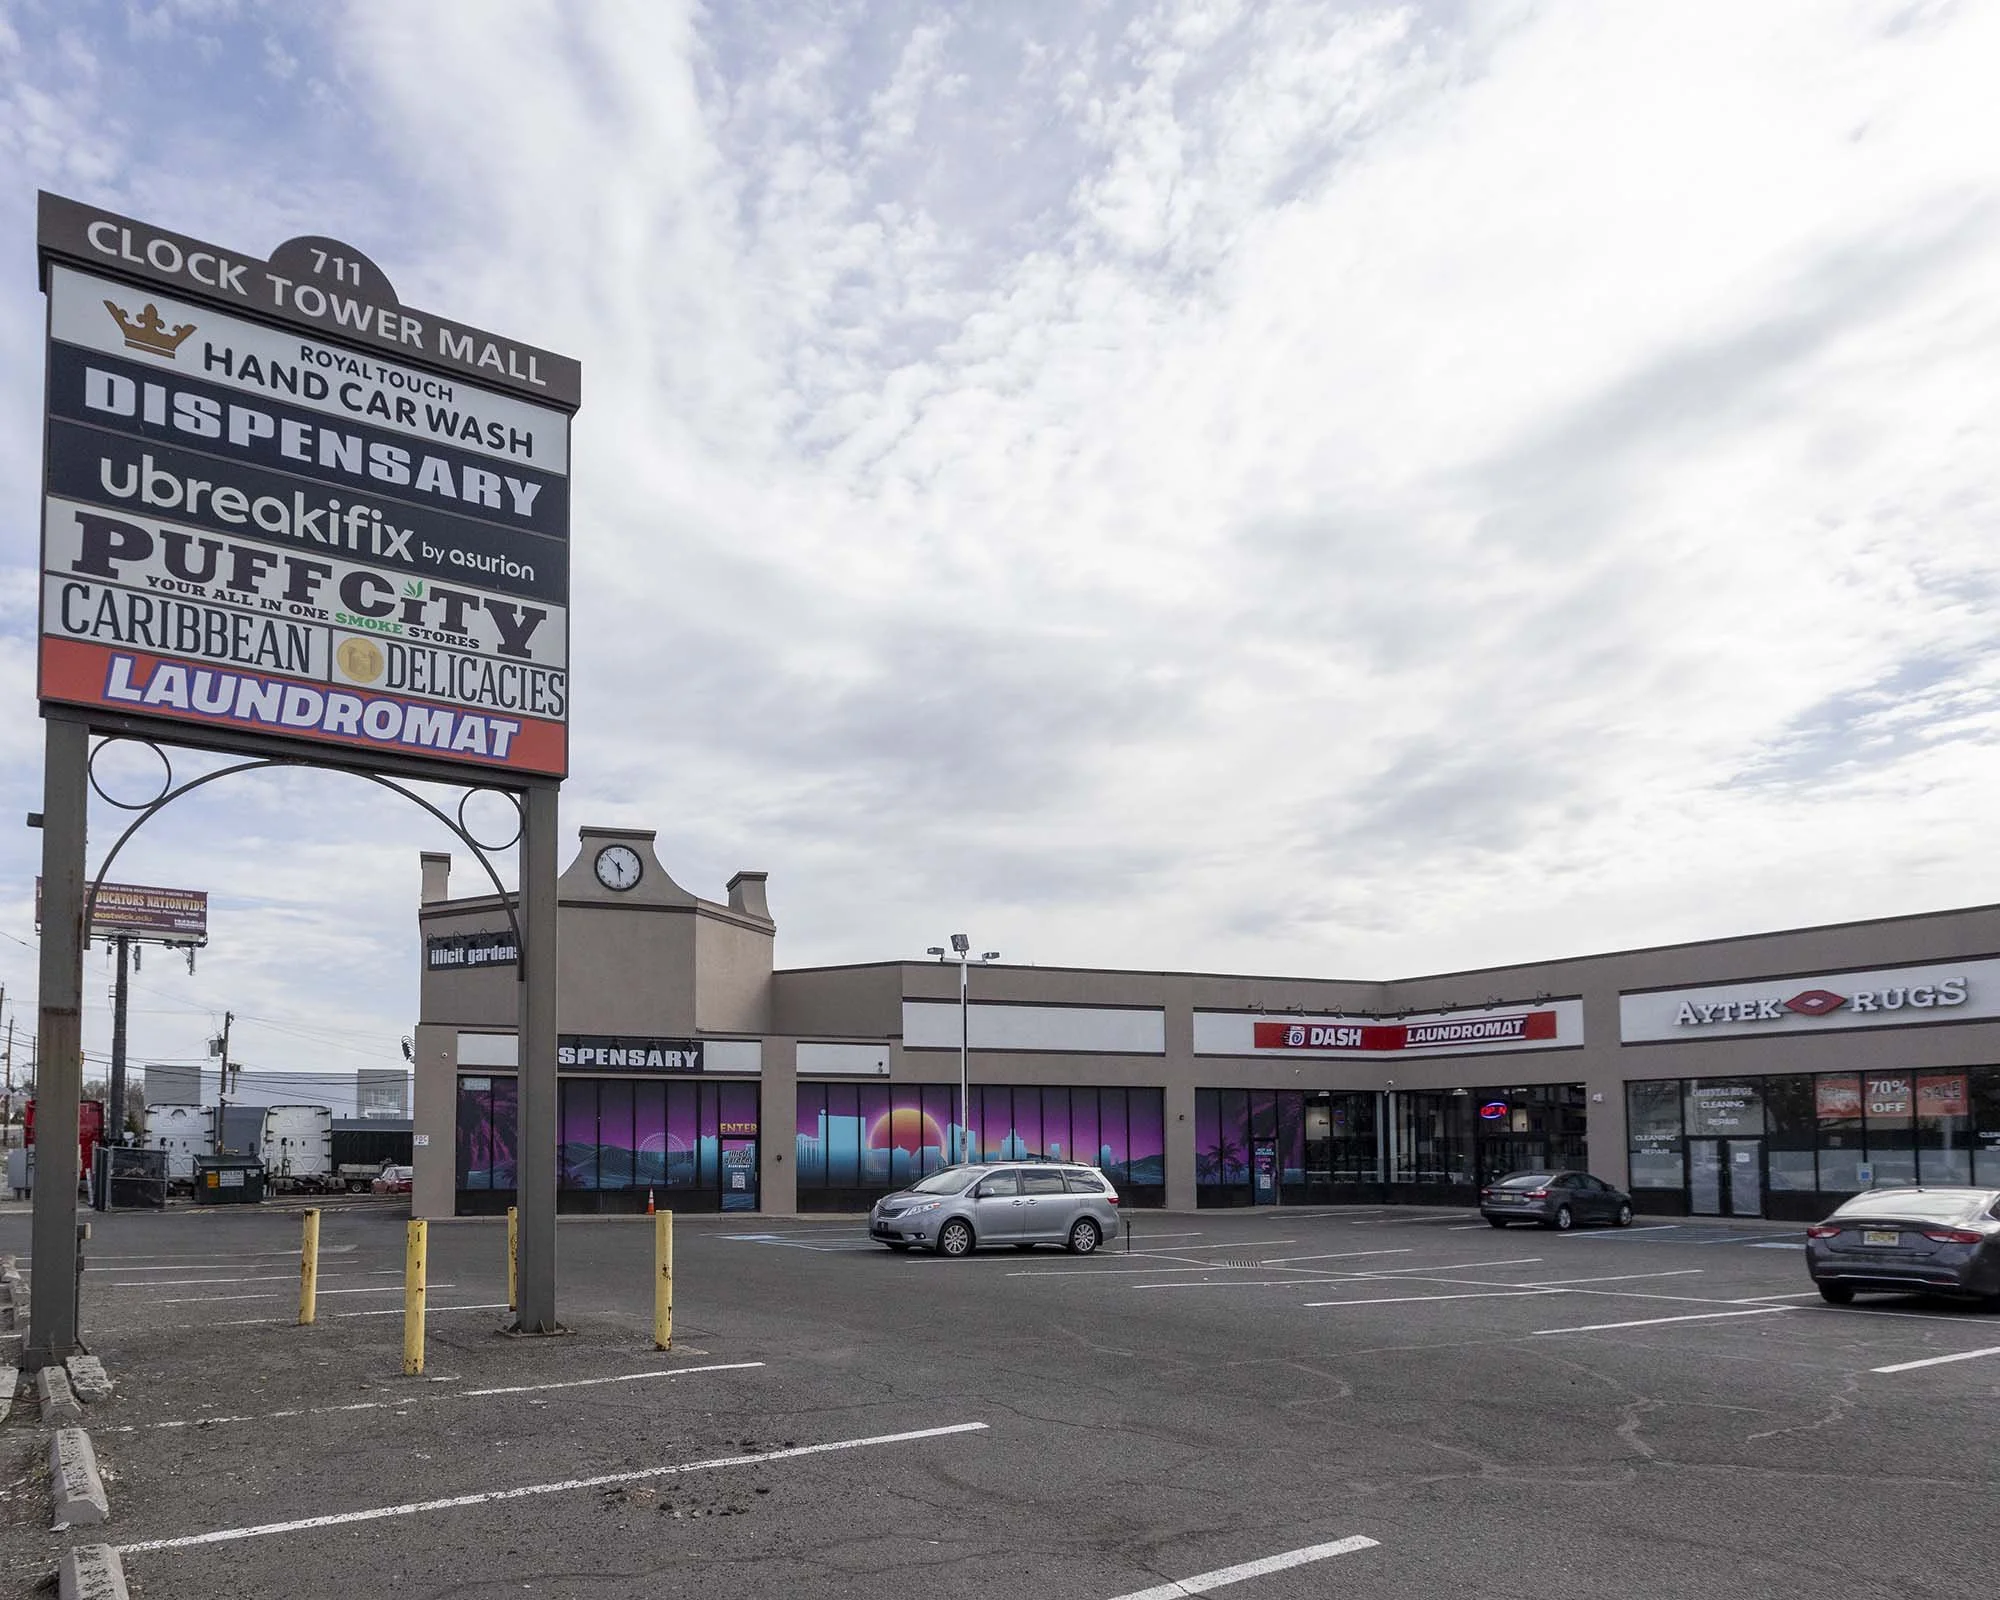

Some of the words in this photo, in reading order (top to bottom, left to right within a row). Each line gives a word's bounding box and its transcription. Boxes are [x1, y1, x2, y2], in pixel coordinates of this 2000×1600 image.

[310, 248, 360, 287] 711
[87, 221, 248, 296] CLOCK
[265, 273, 424, 349] TOWER
[439, 327, 547, 386] MALL
[301, 345, 372, 380] ROYAL
[376, 367, 452, 402] TOUCH
[204, 342, 329, 400] HAND
[339, 382, 416, 427] CAR
[425, 404, 533, 458] WASH
[85, 366, 542, 517] DISPENSARY
[101, 454, 414, 562] ubreakifix
[422, 542, 445, 564] by
[450, 549, 535, 581] asurion
[146, 575, 206, 597] YOUR
[212, 588, 253, 606] ALL
[260, 598, 283, 612] IN
[289, 604, 329, 621] ONE
[335, 612, 403, 634] SMOKE
[408, 627, 480, 649] STORES
[61, 582, 313, 674] CARIBBEAN
[385, 642, 564, 717] DELICACIES
[105, 653, 520, 759] LAUNDROMAT
[95, 891, 145, 906] DUCATORS
[146, 896, 206, 912] NATIONWIDE
[431, 947, 464, 965] illicit
[1672, 998, 1782, 1026] AYTEK
[1852, 976, 1968, 1013] RUGS
[1310, 1027, 1362, 1046] DASH
[1406, 1019, 1525, 1042] LAUNDROMAT
[558, 1047, 699, 1068] SPENSARY
[1701, 1100, 1745, 1109] CLEANING
[1868, 1080, 1910, 1095] 70%
[1921, 1080, 1962, 1099] SALE
[1872, 1102, 1907, 1113] OFF
[720, 1123, 757, 1133] ENTER
